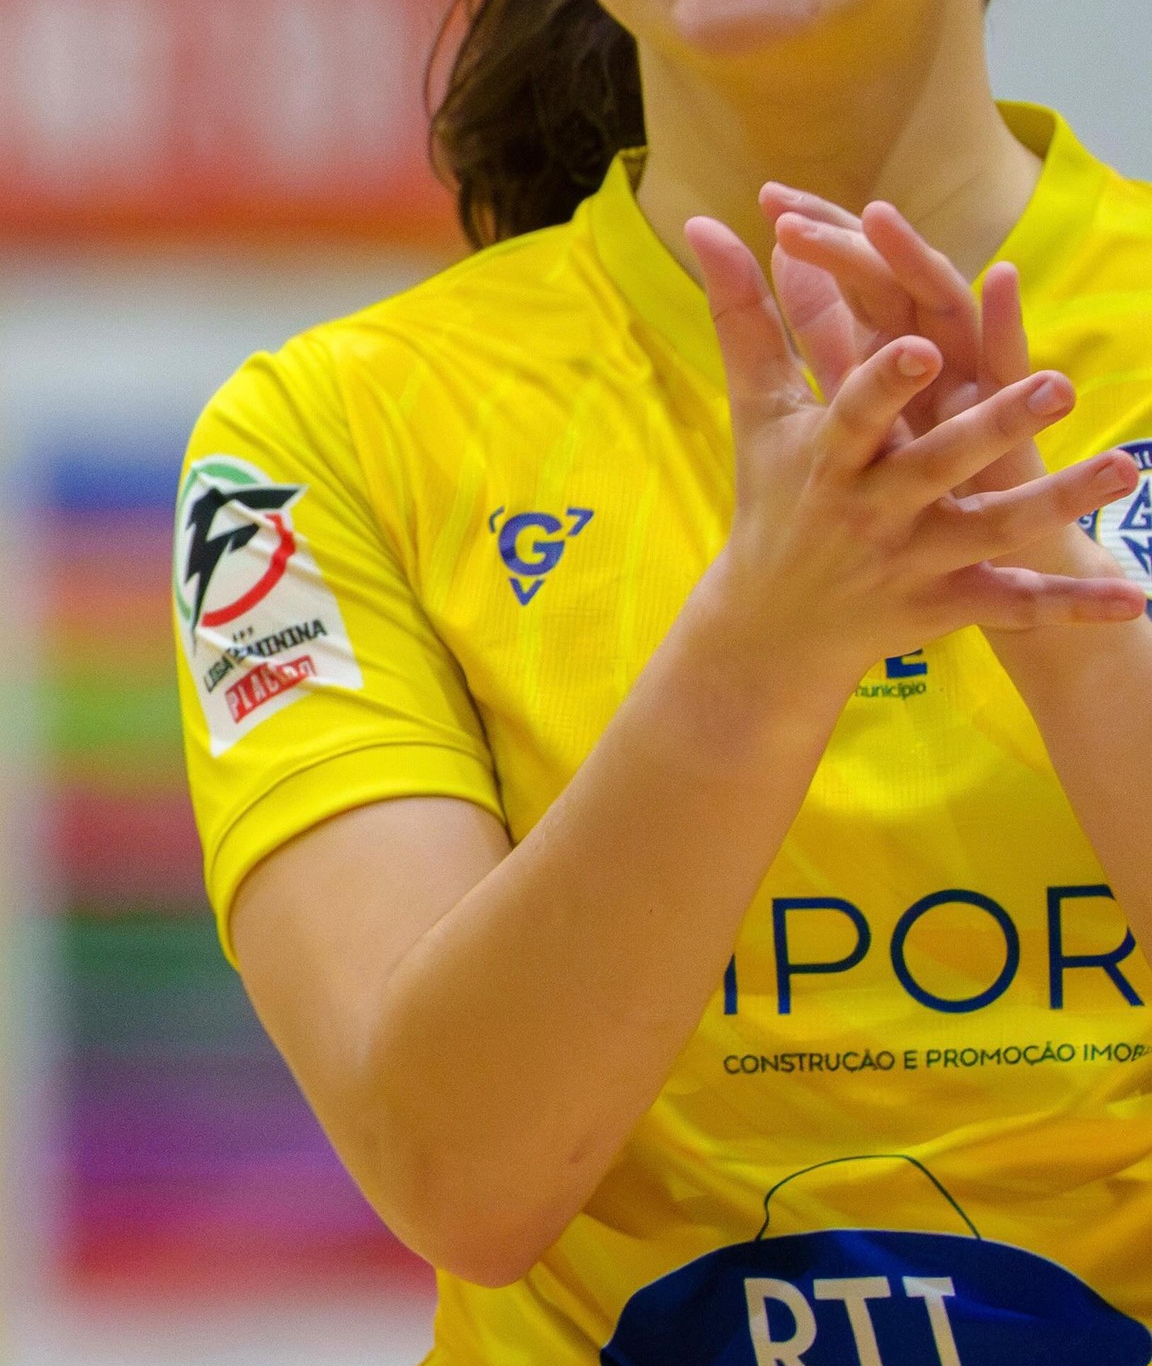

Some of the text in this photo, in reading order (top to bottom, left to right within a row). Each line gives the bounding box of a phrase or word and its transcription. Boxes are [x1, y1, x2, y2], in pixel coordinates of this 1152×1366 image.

[723, 1048, 895, 1075] CONSTRUÇÃO
[903, 1050, 918, 1071] E
[926, 1040, 1075, 1068] PROMOÇÃO
